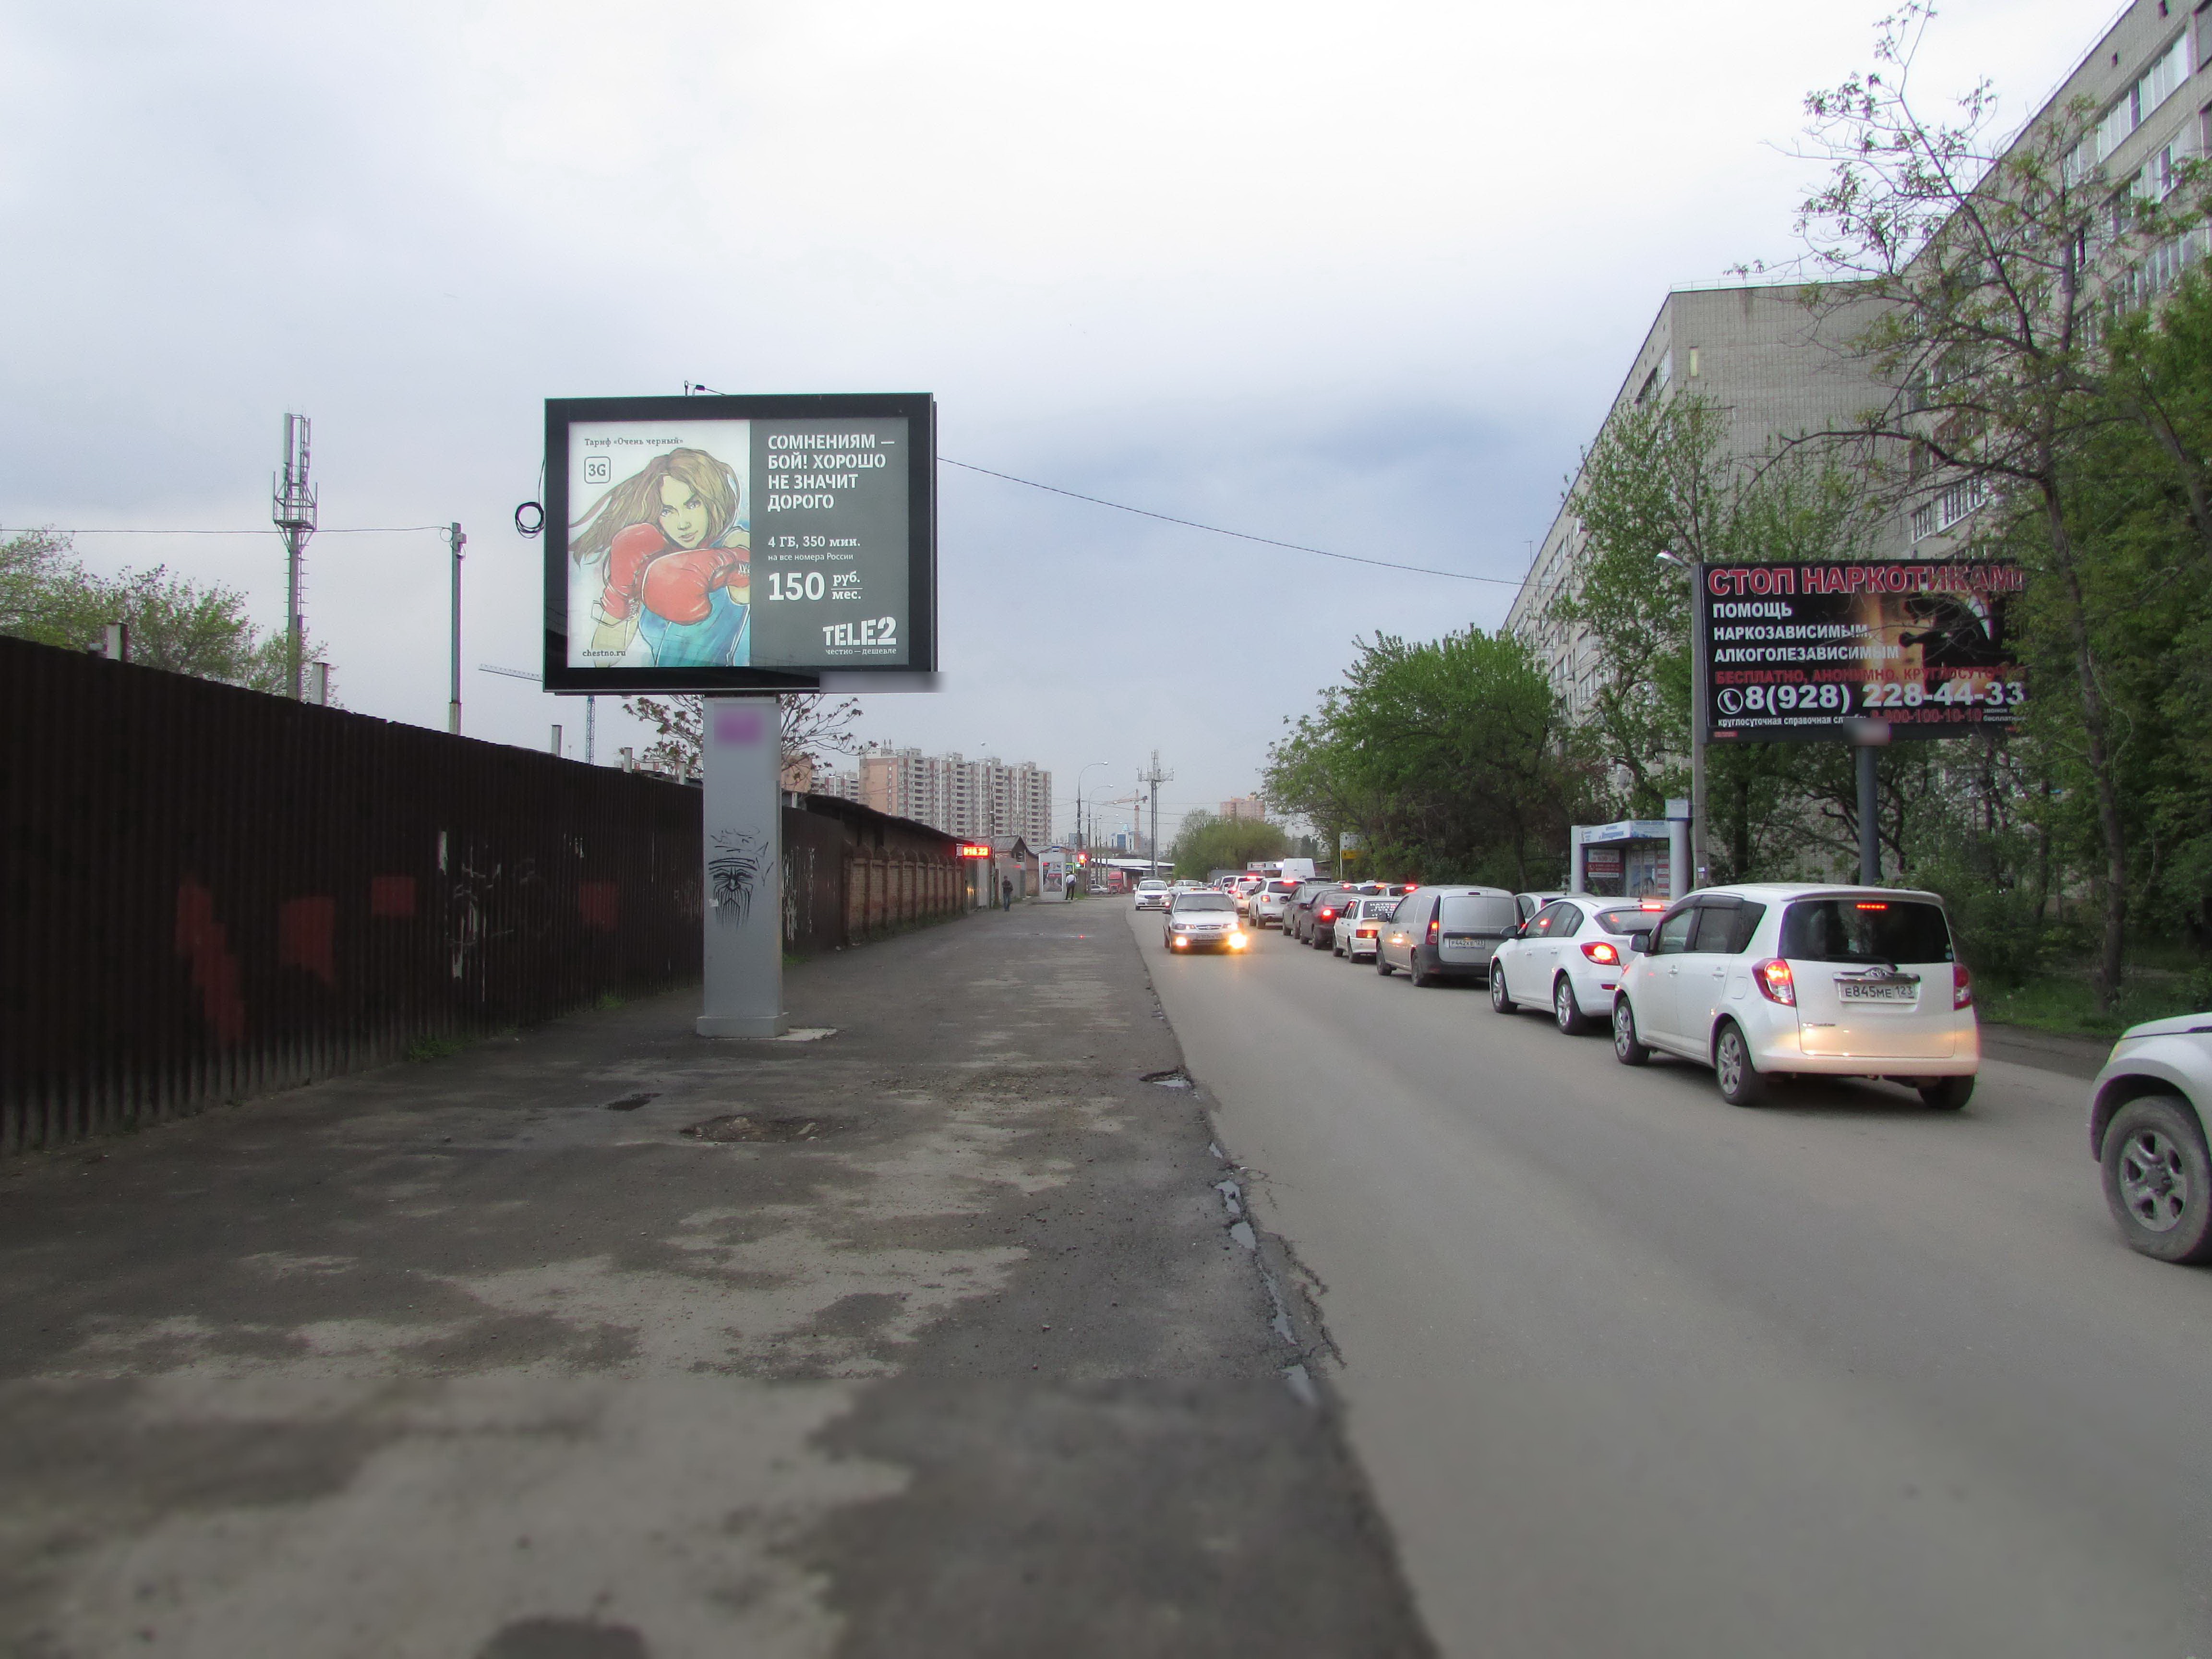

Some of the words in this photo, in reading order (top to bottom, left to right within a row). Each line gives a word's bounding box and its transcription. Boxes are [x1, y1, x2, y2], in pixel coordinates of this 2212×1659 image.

[585, 438, 611, 447] Тариф
[614, 437, 644, 445] «Очень
[646, 437, 683, 446] черный»
[768, 434, 875, 450] СОМНЕНИЯМ
[769, 452, 807, 469] БОЙ!
[813, 454, 886, 469] ХОРОШО
[589, 464, 606, 476] 3G
[769, 475, 790, 489] НЕ
[794, 474, 858, 489] ЗНАЧИТ
[768, 494, 834, 512] ДОРОГО
[768, 537, 776, 547] 4
[780, 536, 799, 549] ГБ,
[803, 536, 826, 547] 350
[829, 539, 861, 547] мин.
[769, 572, 825, 601] 150
[833, 570, 861, 587] руб.
[1708, 568, 1794, 596] СТОП
[832, 590, 861, 600] мес.
[1713, 601, 1792, 620] ПОМОЩЬ
[823, 616, 897, 646] TELE2
[1715, 669, 1808, 684] БЕСПЛАТНО,
[1745, 684, 1851, 715] 8(928)
[1862, 682, 2024, 707] 228-44-33
[1718, 718, 1781, 727] круглосуточная
[1784, 717, 1831, 725] справочная
[1845, 986, 1892, 998] Е845МЕ
[1896, 986, 1912, 995] 123
